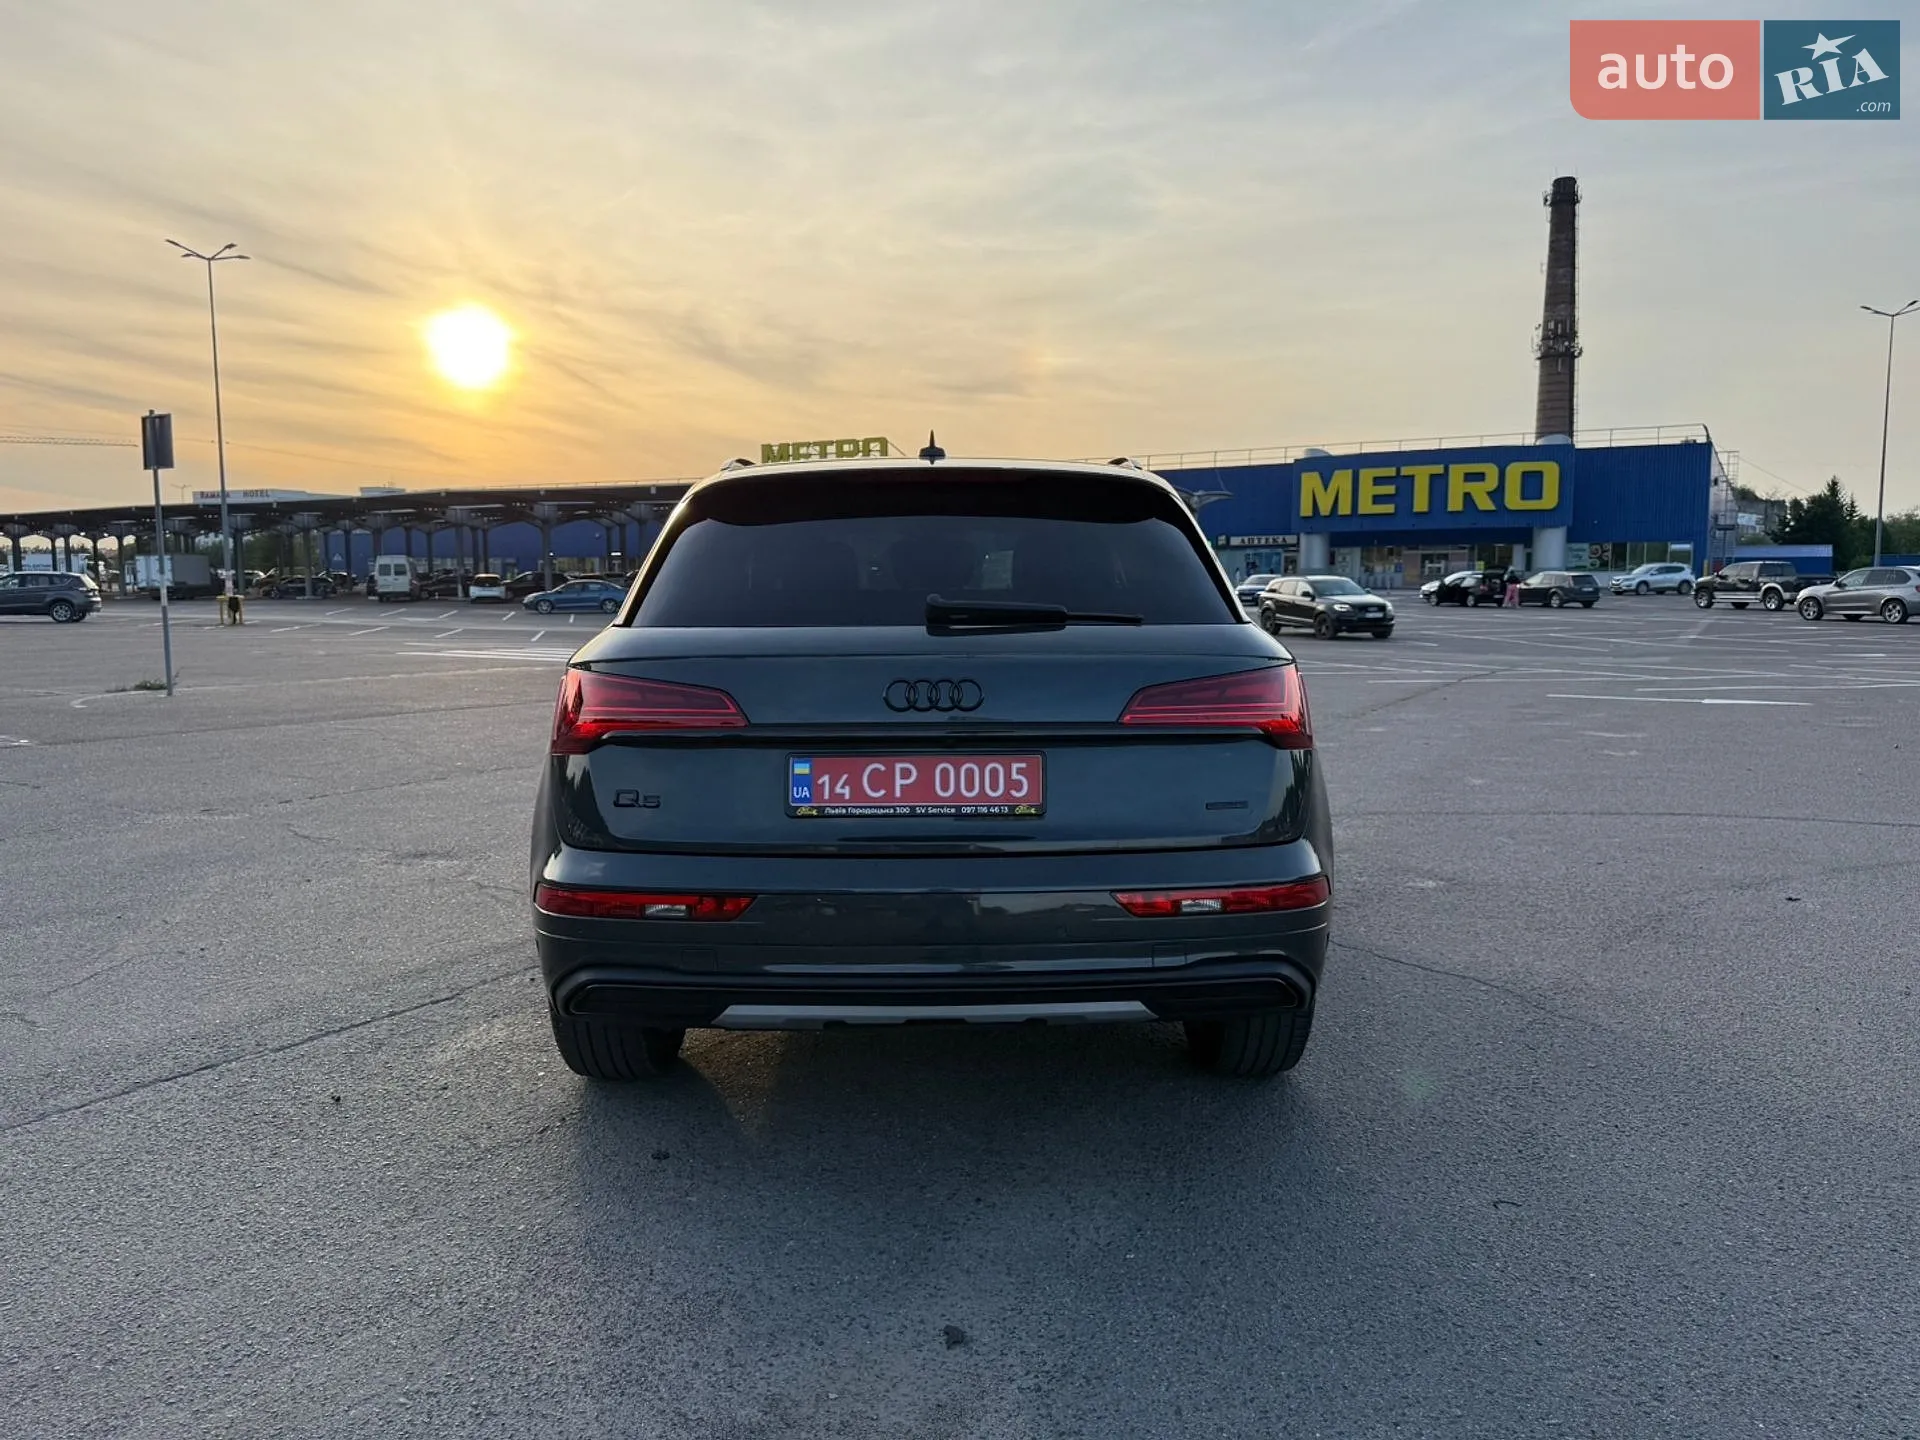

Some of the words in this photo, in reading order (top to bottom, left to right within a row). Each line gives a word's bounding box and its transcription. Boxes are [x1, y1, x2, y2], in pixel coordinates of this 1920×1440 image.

[200, 490, 231, 499] RAMAA
[242, 488, 270, 498] HOTEL
[1299, 460, 1560, 517] METRO
[1239, 536, 1288, 545] АПТЕКА
[793, 786, 810, 798] UA
[817, 773, 851, 800] 14
[862, 762, 918, 798] CP
[934, 762, 1029, 798] 0005
[613, 789, 661, 809] Q5
[915, 806, 927, 814] SV
[928, 806, 956, 814] Service
